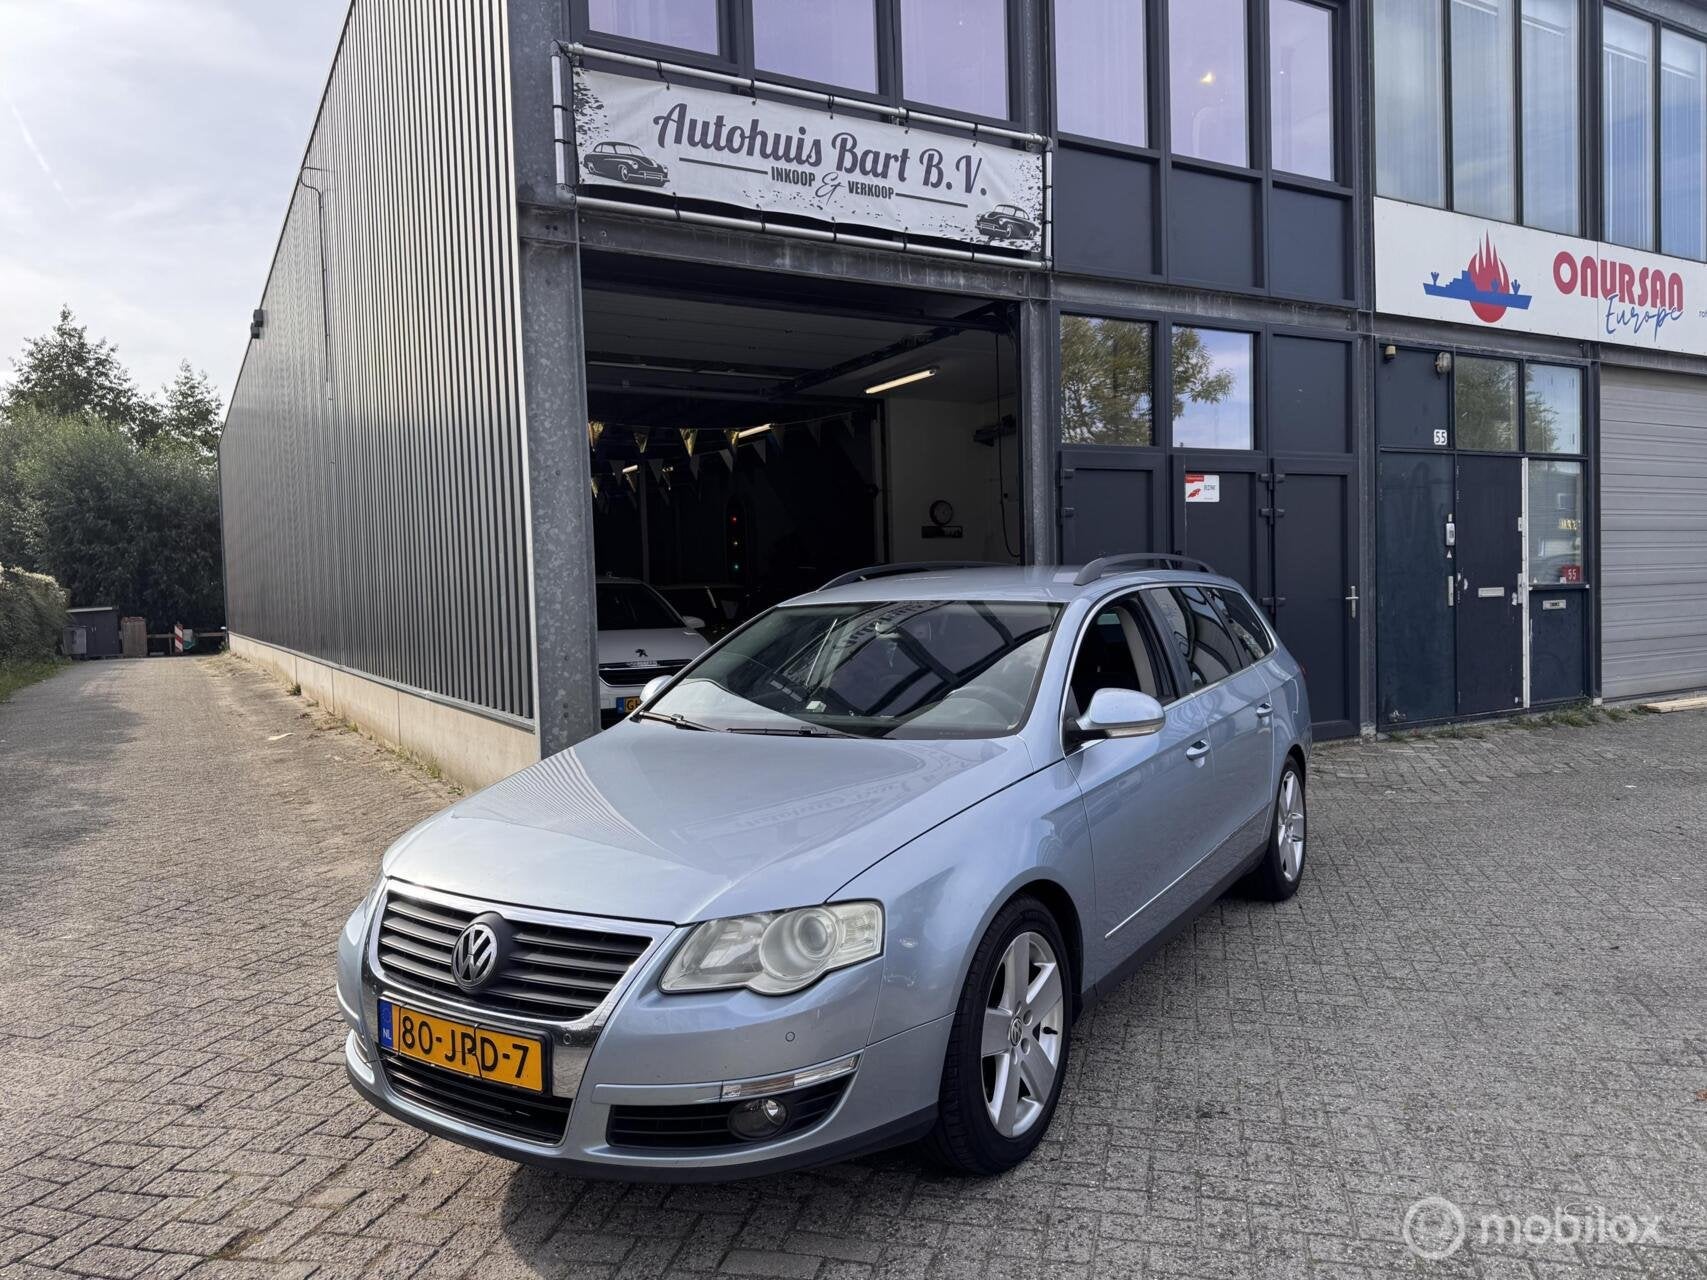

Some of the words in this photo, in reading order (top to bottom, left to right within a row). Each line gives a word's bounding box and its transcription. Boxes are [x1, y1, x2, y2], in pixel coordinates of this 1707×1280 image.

[653, 103, 822, 167] Autohuis
[831, 132, 911, 182] Bart
[918, 148, 987, 196] B.V.
[771, 166, 816, 187] INKOOP
[847, 180, 894, 200] VERKOOP
[1605, 294, 1684, 341] Europe
[1435, 431, 1446, 443] 55
[1568, 568, 1577, 580] 55
[402, 1015, 530, 1079] 80-JPD-7
